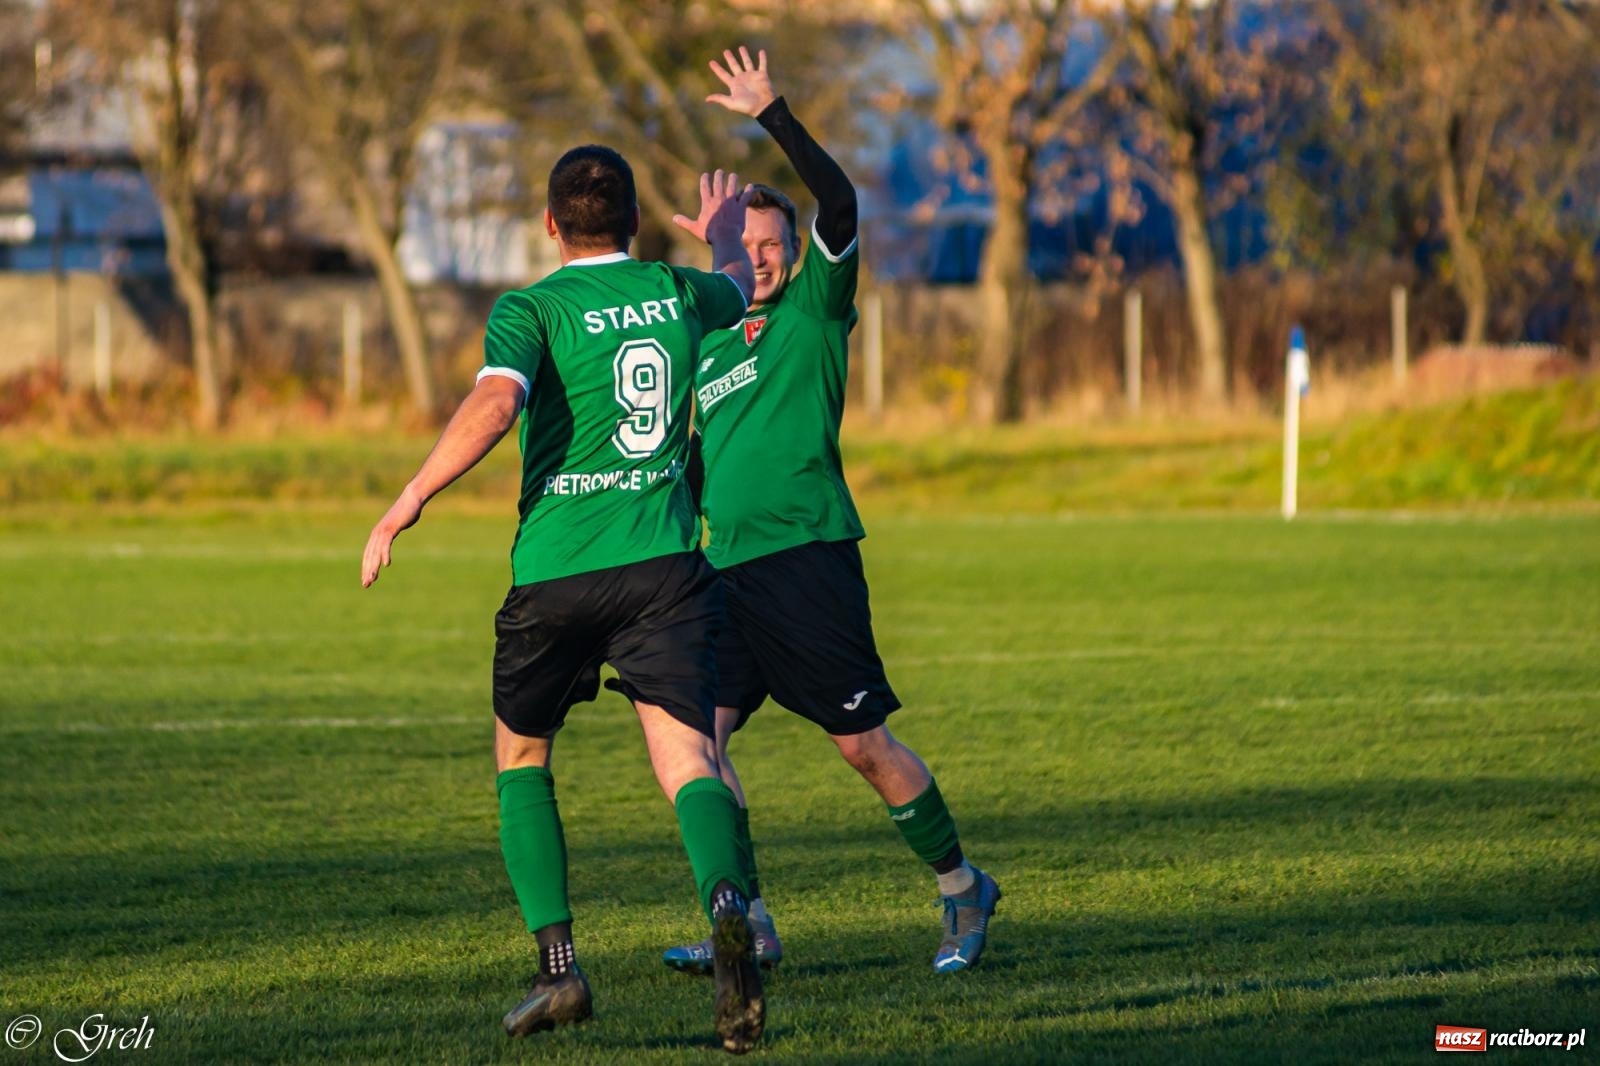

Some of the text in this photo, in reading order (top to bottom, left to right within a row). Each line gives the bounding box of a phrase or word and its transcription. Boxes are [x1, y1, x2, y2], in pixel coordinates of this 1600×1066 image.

[584, 297, 679, 334] START
[611, 338, 672, 459] 9
[698, 362, 758, 408] SILVER STAL
